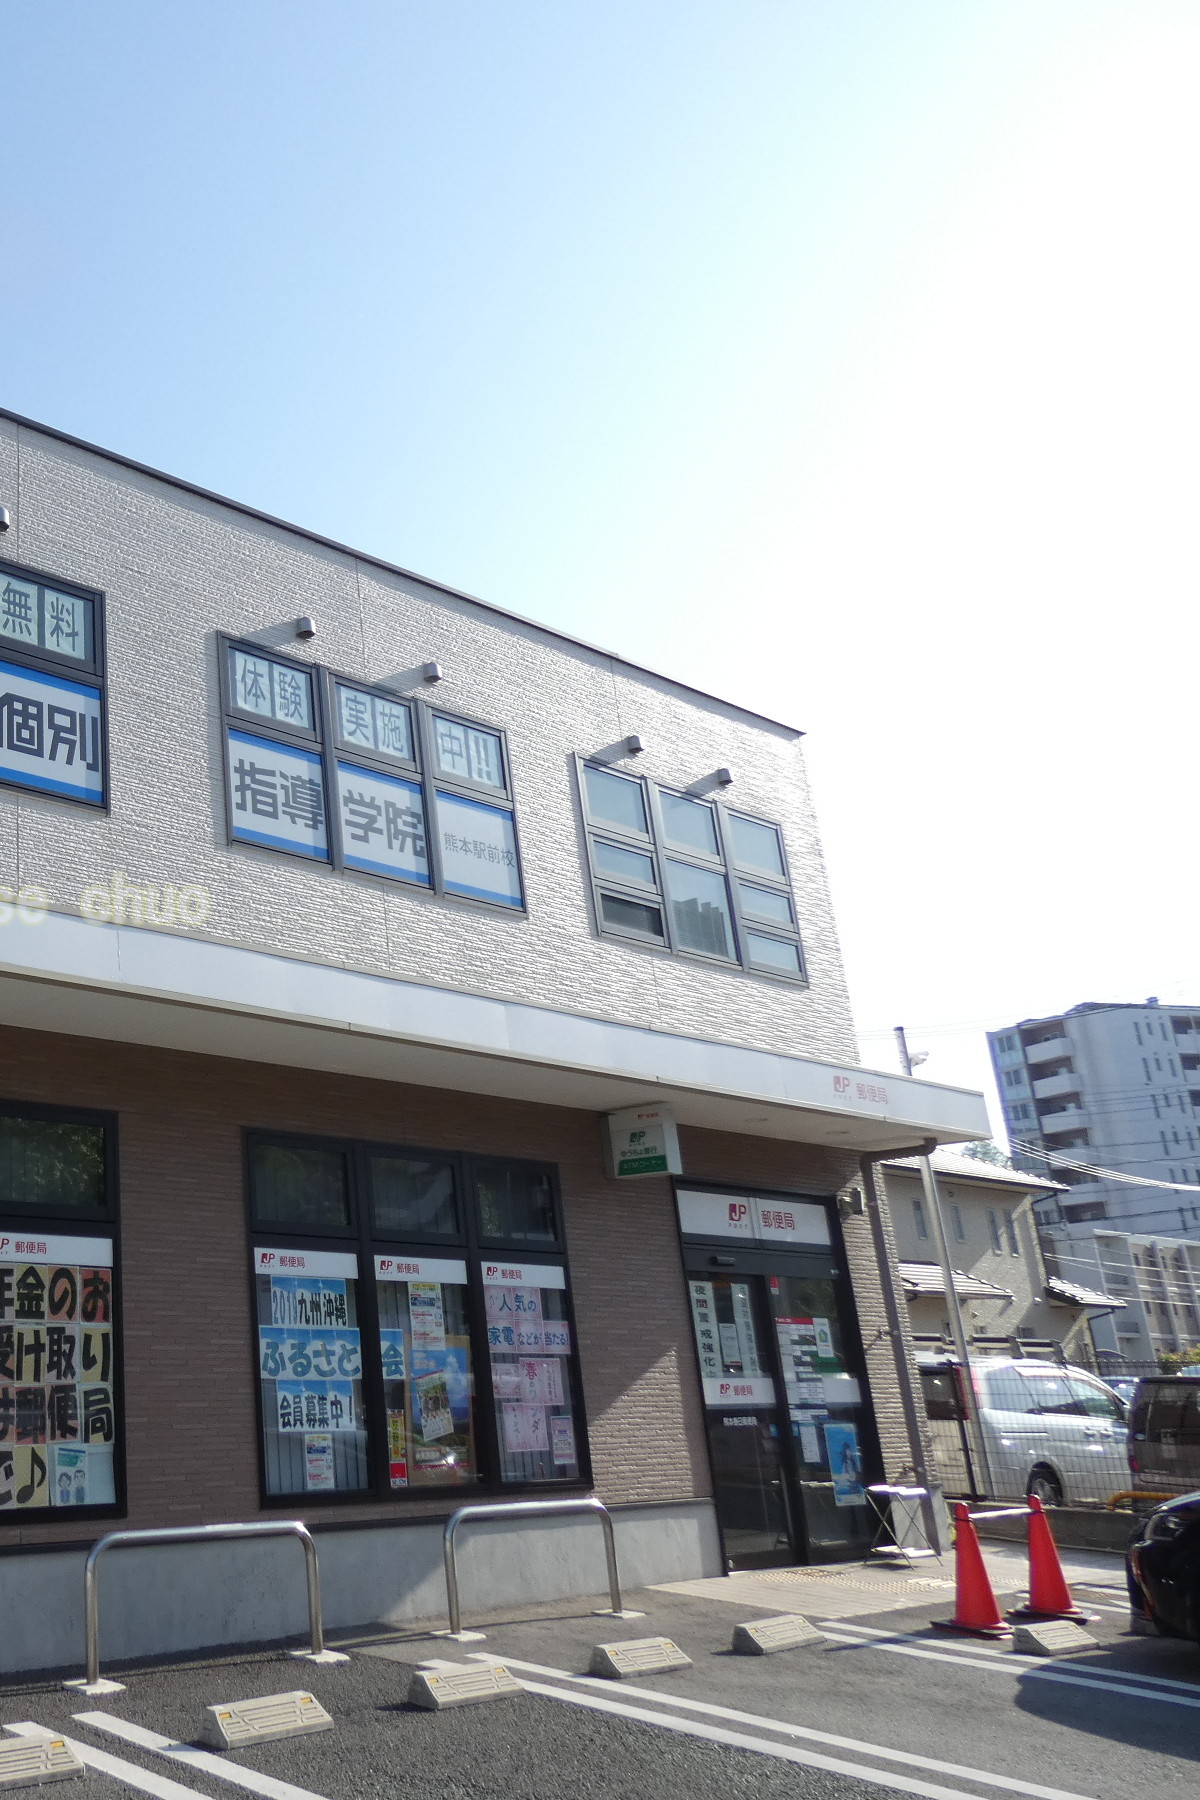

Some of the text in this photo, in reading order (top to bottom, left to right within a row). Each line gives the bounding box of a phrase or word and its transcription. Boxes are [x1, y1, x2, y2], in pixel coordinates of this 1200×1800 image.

[1, 582, 79, 652] 無料
[241, 658, 303, 721] 体験
[344, 694, 404, 753] 実施
[233, 759, 426, 859] 指導 学院
[443, 832, 515, 868] 熊本駅前校
[856, 1083, 889, 1104] 郵便局
[761, 1210, 796, 1230] 郵便局
[15, 1242, 47, 1254] 郵便局
[280, 1256, 305, 1268] 郵便局
[396, 1263, 420, 1274] 郵便局
[501, 1269, 522, 1280] 郵便局
[499, 1293, 537, 1312] 人気の
[261, 1341, 405, 1378] ふるさと 会
[733, 1385, 754, 1396] 郵便局
